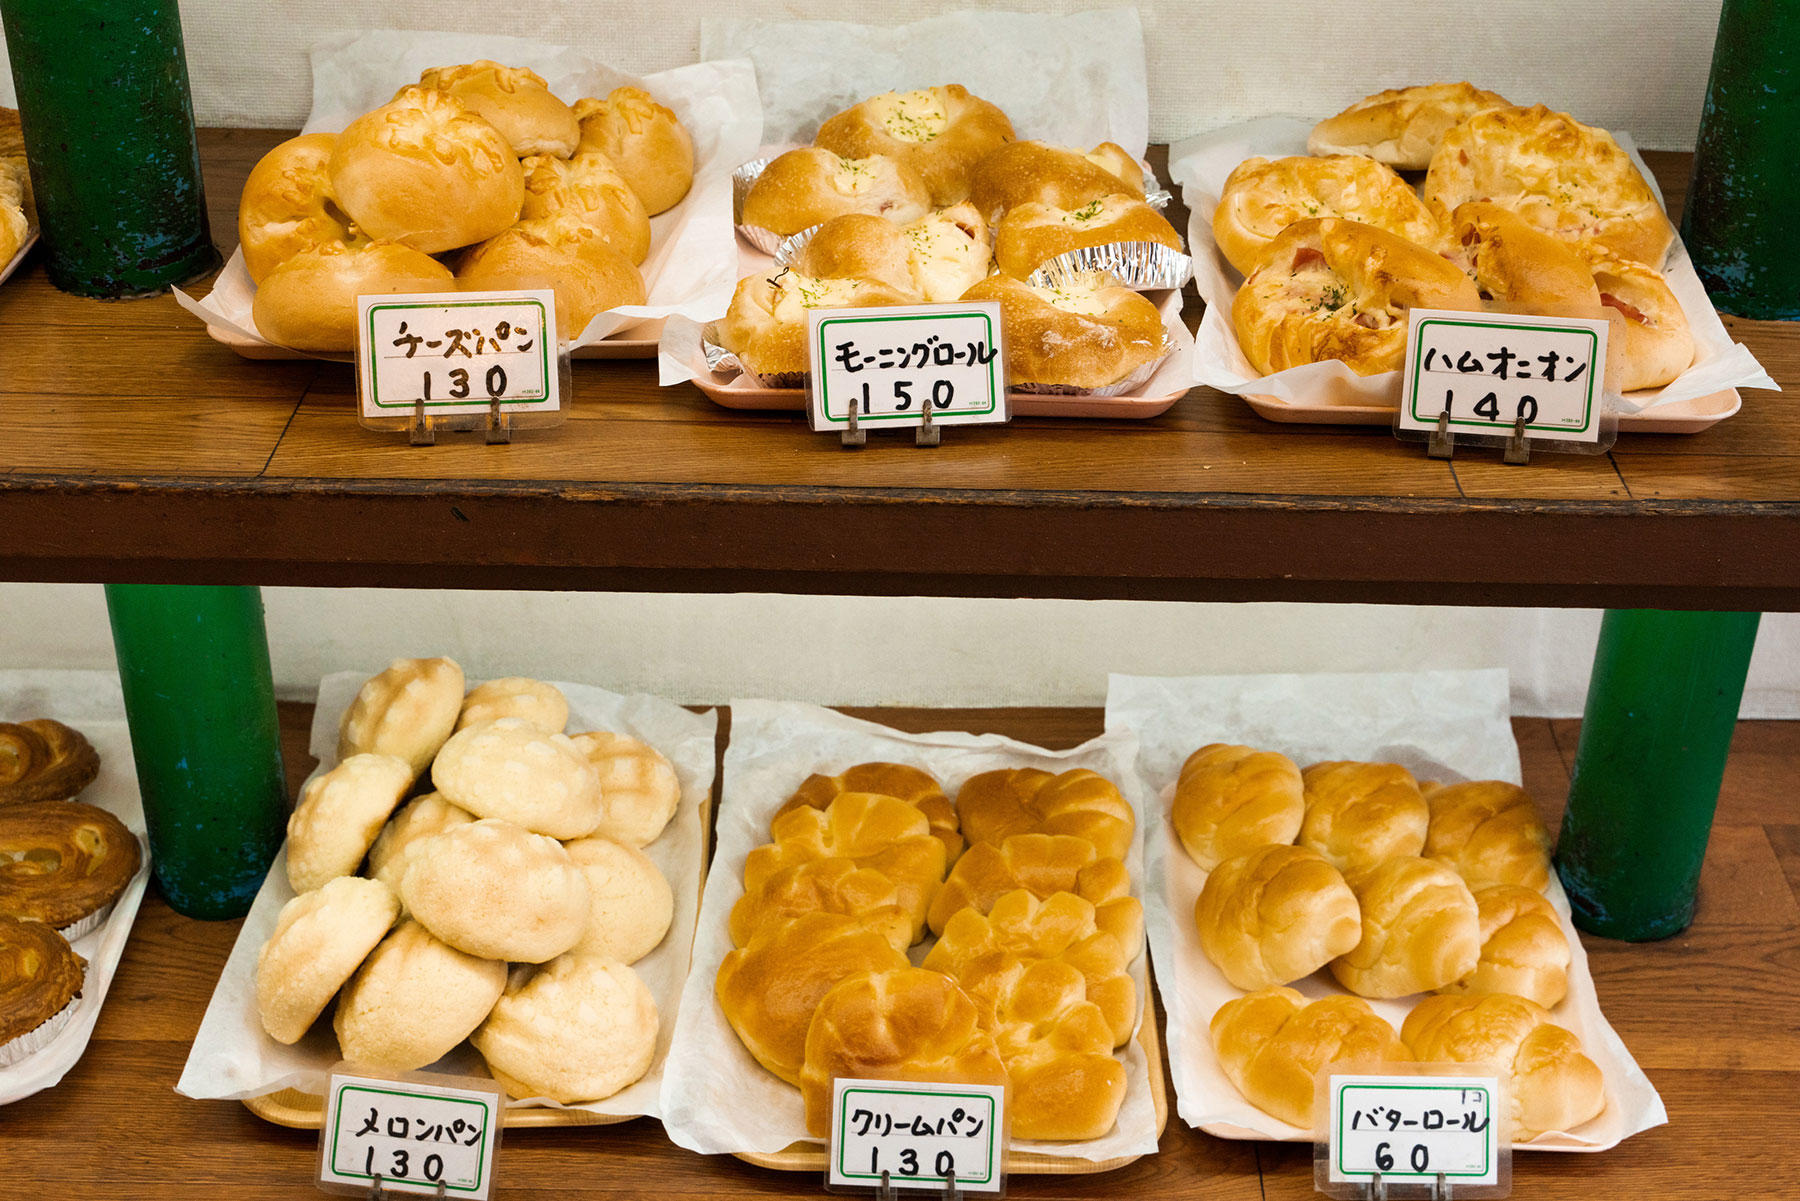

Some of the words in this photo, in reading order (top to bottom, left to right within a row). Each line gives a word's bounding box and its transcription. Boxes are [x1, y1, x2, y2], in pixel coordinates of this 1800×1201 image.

[835, 335, 998, 373] モーニングロール
[1424, 346, 1587, 382] ハムオニオン
[423, 364, 508, 400] 130
[862, 379, 955, 414] 150
[1445, 389, 1538, 425] 140
[355, 1107, 483, 1147] メロンパン
[851, 1108, 984, 1137] クリームパン
[1352, 1106, 1490, 1132] バターロール
[365, 1145, 444, 1182] 130
[871, 1146, 955, 1177] 130
[1375, 1142, 1429, 1173] 60
